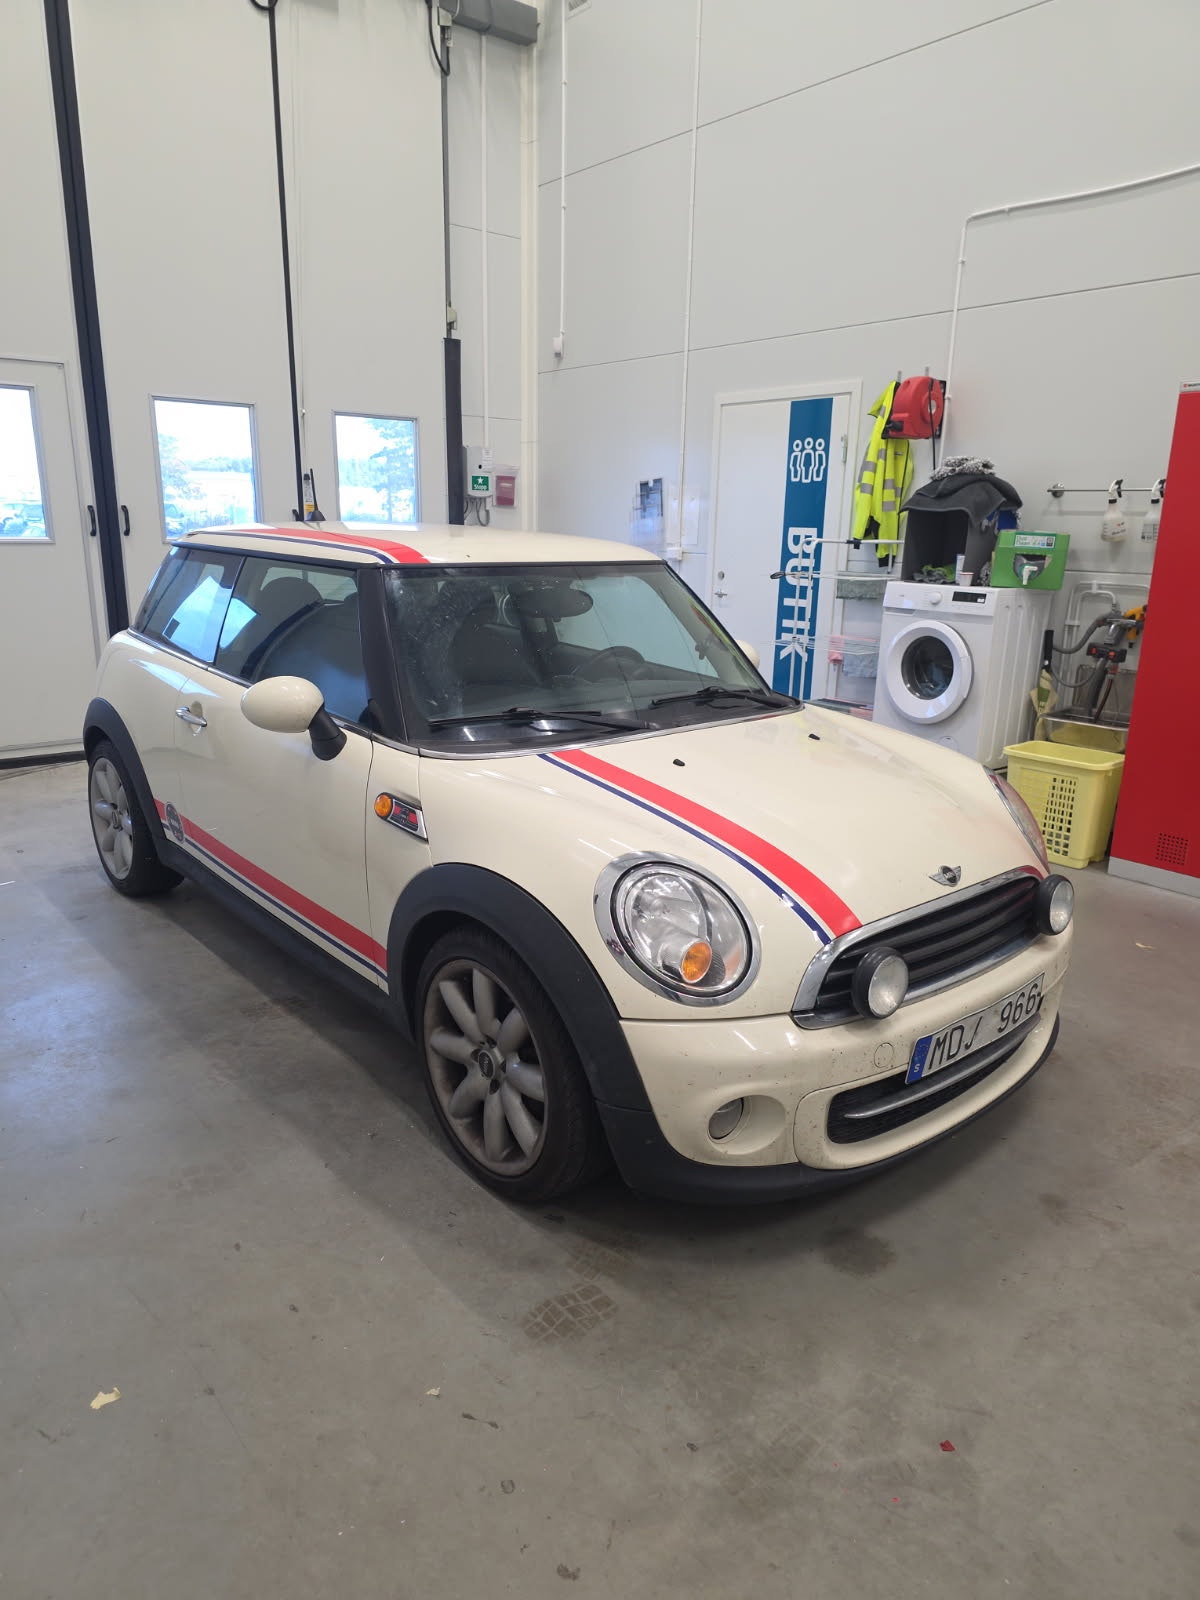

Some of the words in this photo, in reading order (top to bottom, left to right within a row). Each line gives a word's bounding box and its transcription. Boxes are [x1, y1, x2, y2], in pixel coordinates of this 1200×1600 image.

[779, 526, 818, 661] BUTIK
[913, 1063, 920, 1073] S
[928, 1016, 983, 1070] MDJ
[998, 983, 1038, 1033] 966
